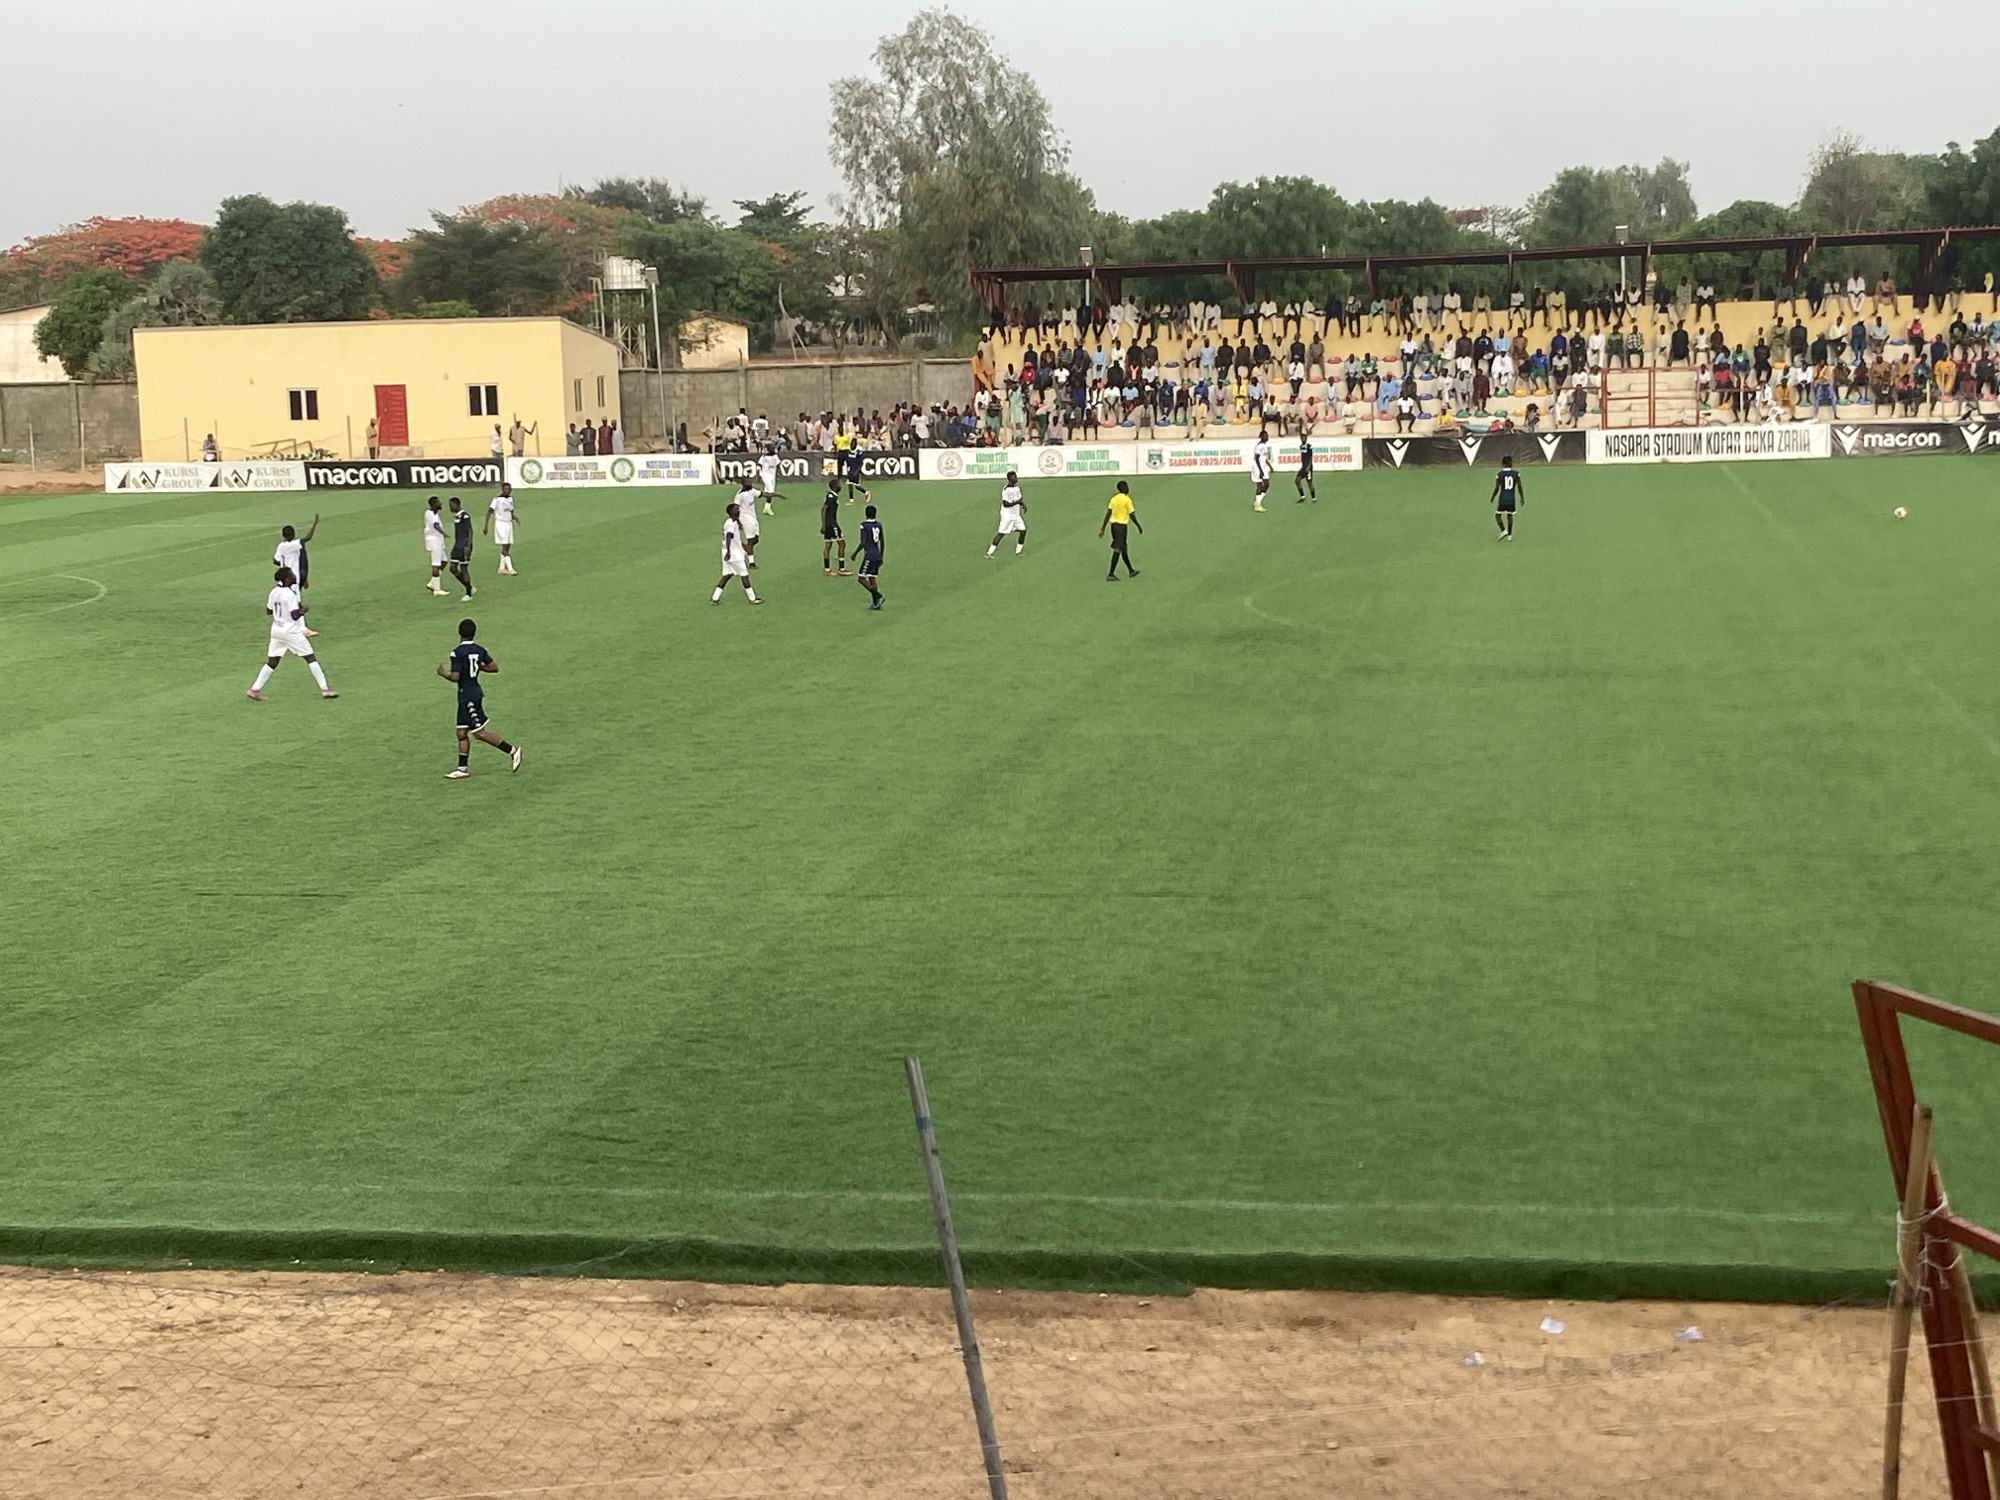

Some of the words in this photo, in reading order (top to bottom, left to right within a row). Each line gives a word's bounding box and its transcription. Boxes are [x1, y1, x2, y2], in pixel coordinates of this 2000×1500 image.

[1605, 434, 1650, 457] NASARA
[1653, 433, 1702, 456] STADIUM
[1706, 431, 1741, 454] KOFAR
[1744, 430, 1774, 453] DOKA
[1777, 429, 1811, 452] ZARIA
[1863, 432, 1940, 447] macron
[1169, 458, 1198, 467] SEASON
[1277, 455, 1302, 464] SEASO
[1312, 454, 1353, 464] 025/2026
[164, 468, 199, 477] KURSI
[256, 467, 291, 476] KURSI
[720, 458, 809, 478] maon
[309, 467, 397, 485] macron
[410, 465, 500, 483] macron
[162, 479, 202, 488] GROUP
[254, 478, 295, 488] GROUP
